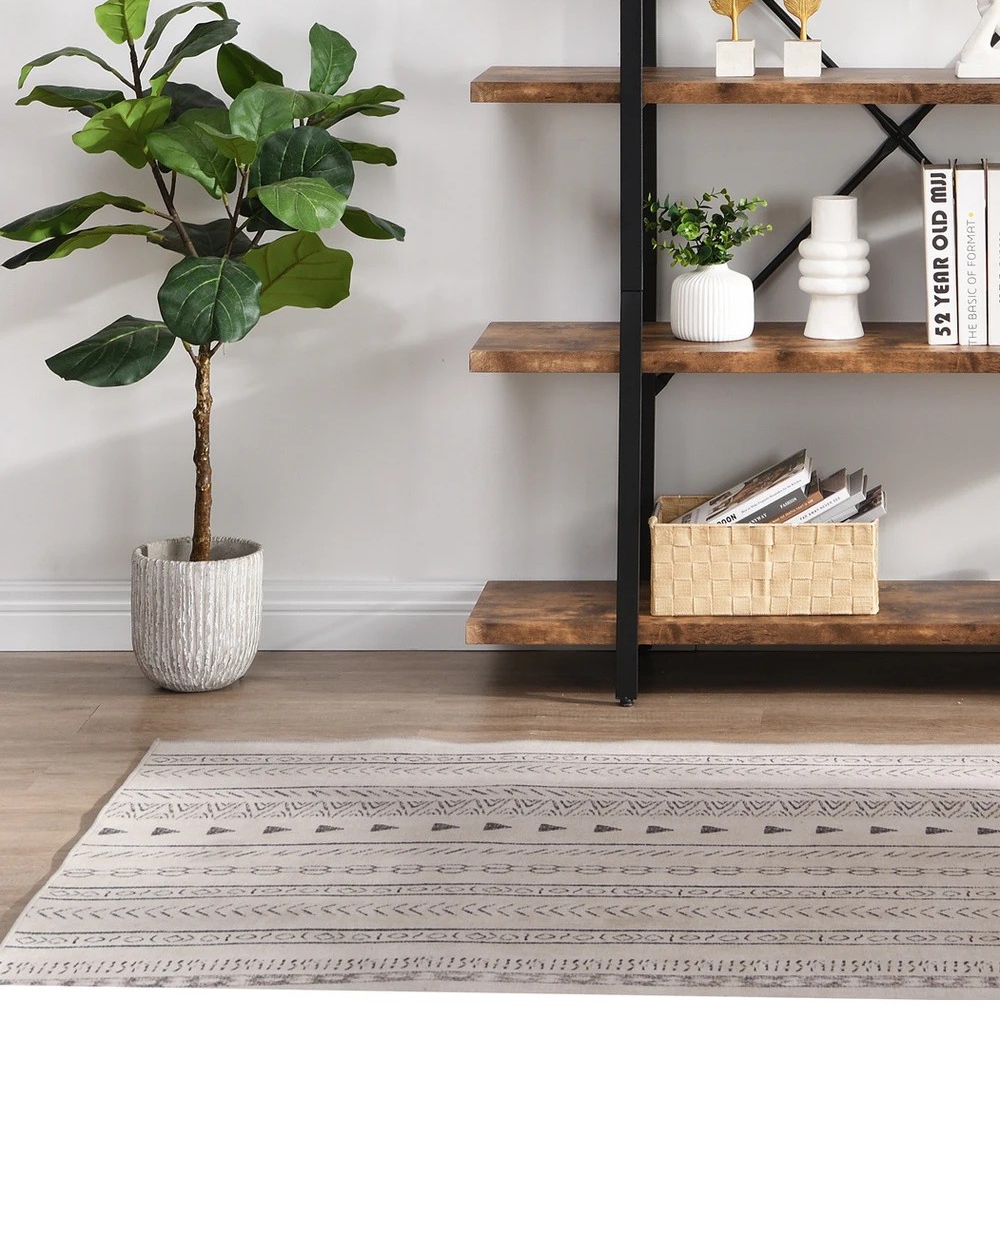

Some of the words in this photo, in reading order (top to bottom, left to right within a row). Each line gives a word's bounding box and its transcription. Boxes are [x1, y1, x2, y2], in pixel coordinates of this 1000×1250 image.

[931, 210, 949, 251] OLD
[966, 219, 977, 267] FORMAT
[933, 257, 949, 308] YEAR
[966, 270, 977, 285] OF
[967, 287, 977, 320] BASIC
[934, 312, 951, 337] 52
[967, 323, 978, 345] THE
